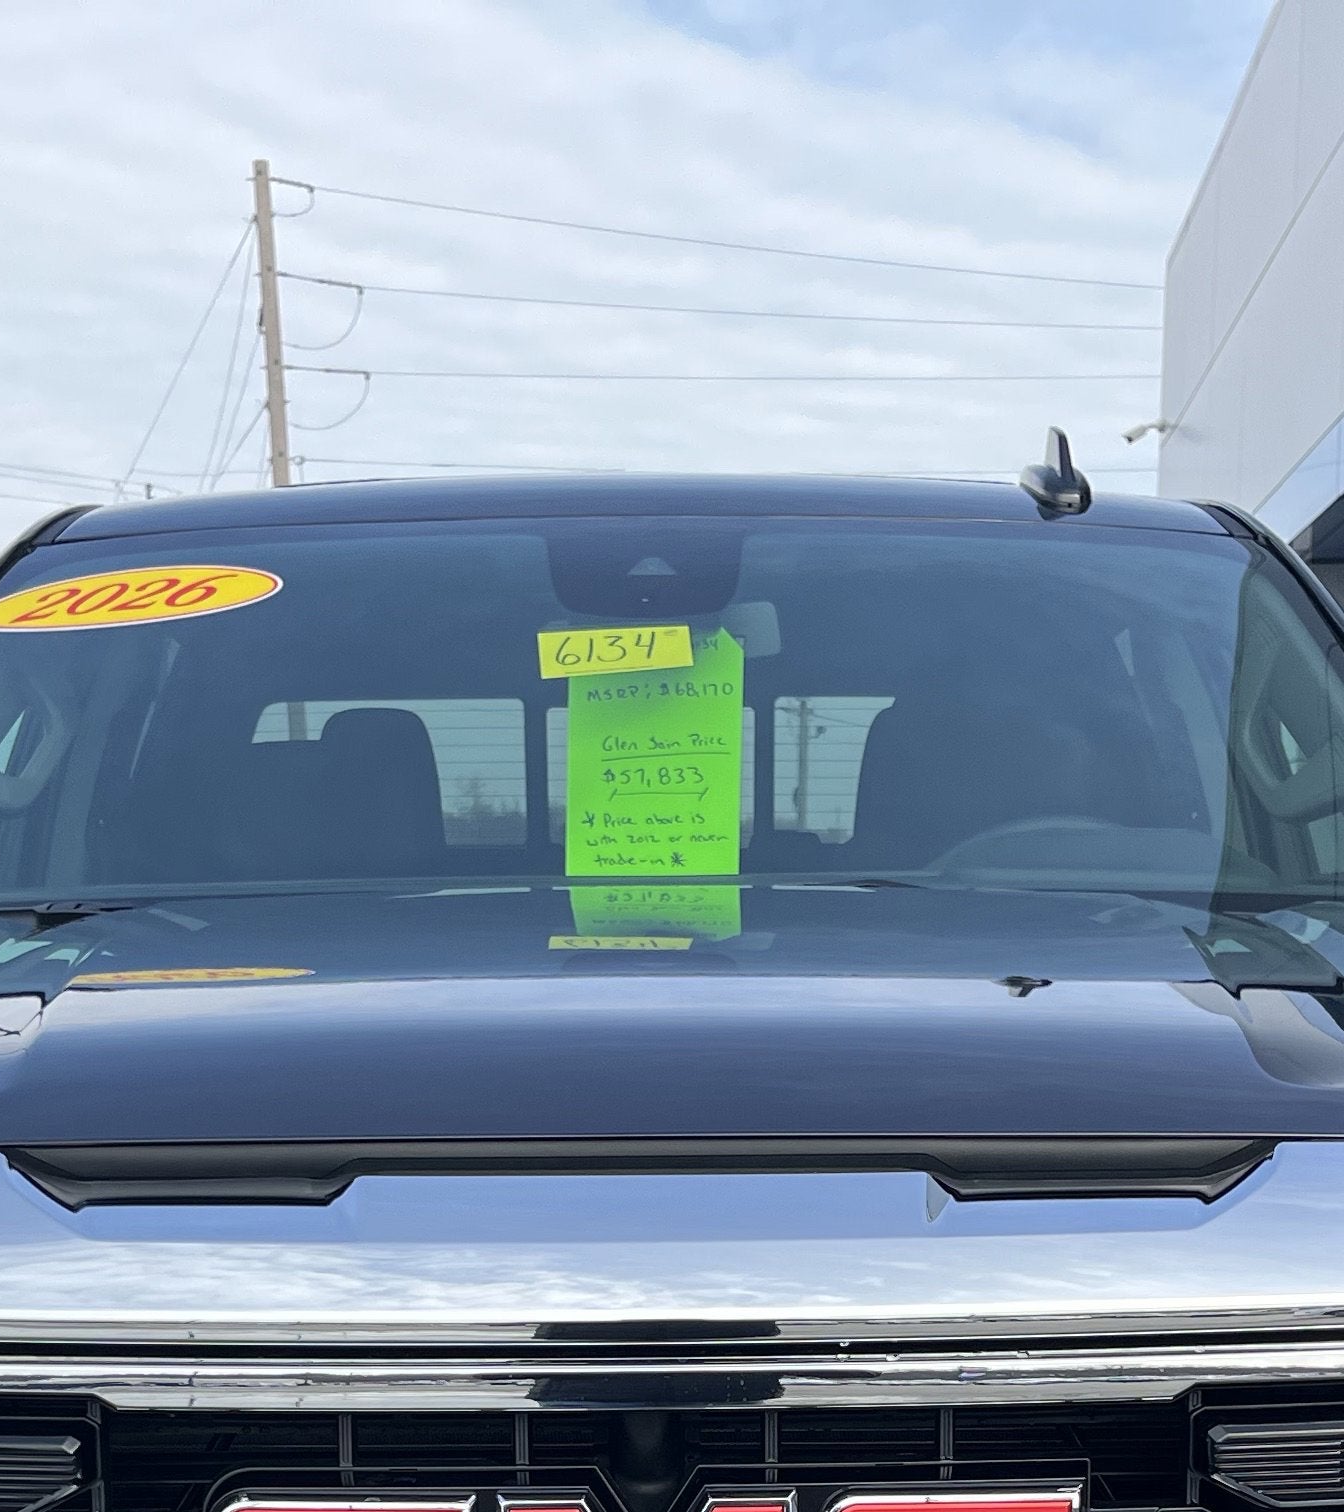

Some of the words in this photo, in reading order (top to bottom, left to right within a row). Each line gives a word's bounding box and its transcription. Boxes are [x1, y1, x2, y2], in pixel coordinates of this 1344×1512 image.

[8, 573, 239, 625] 2026
[556, 631, 656, 666] 6134
[657, 682, 734, 699] $68,170
[602, 735, 638, 752] Glen
[688, 733, 727, 748] Price
[602, 766, 706, 789] $57,833
[603, 813, 637, 828] Price
[645, 812, 684, 825] above
[690, 812, 706, 825] is
[586, 833, 618, 847] with
[594, 853, 665, 868] trade-in
